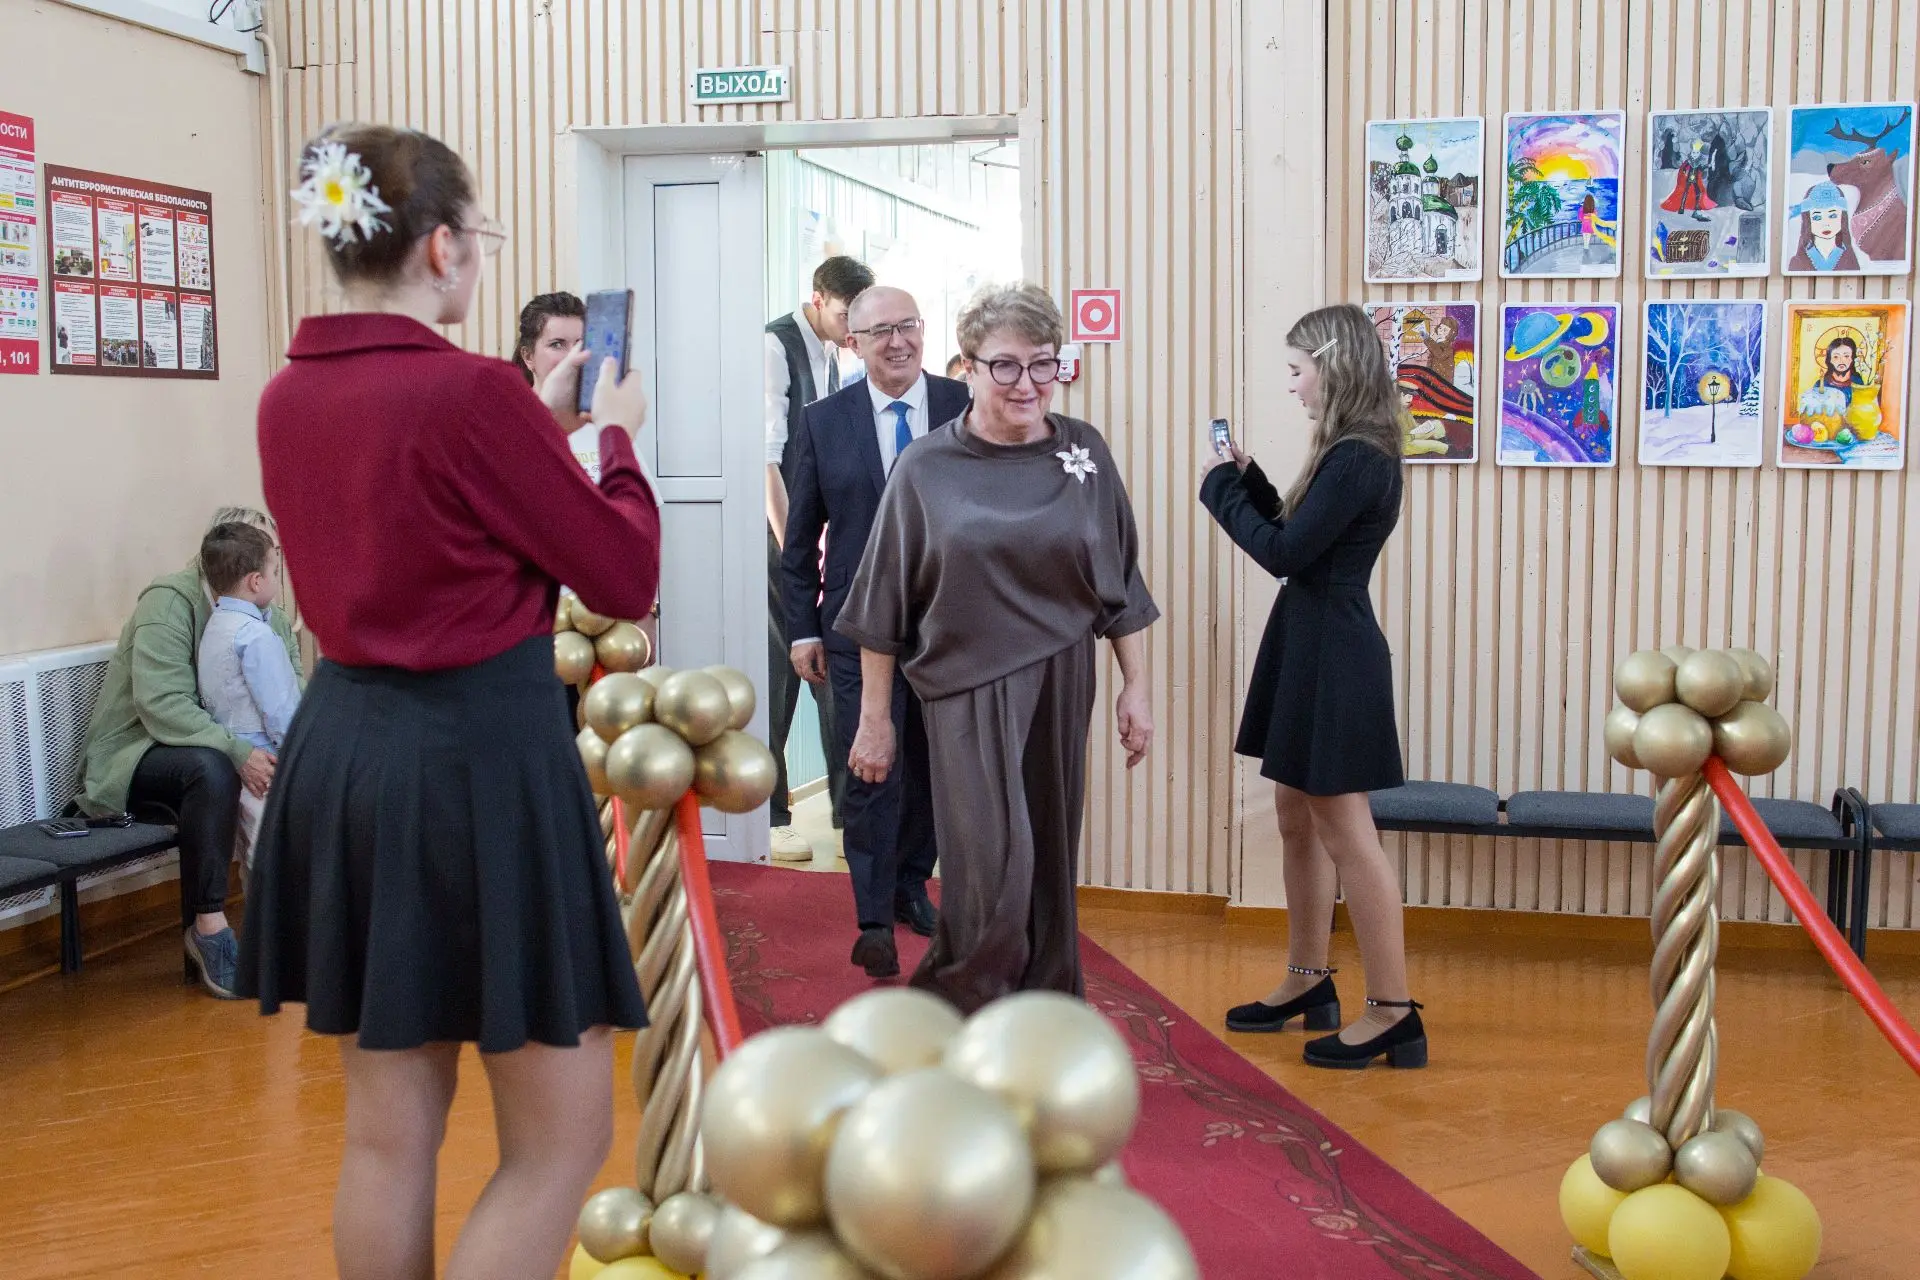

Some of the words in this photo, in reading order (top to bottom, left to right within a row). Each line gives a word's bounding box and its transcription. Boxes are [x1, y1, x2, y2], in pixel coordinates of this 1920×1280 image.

[701, 75, 777, 94] ВЫХОД
[51, 176, 153, 200] АНТИТЕРРОРИСТИЧЕСКАЯ
[155, 194, 208, 210] БЕЗОПАСНОСТЬ
[10, 351, 30, 365] 101
